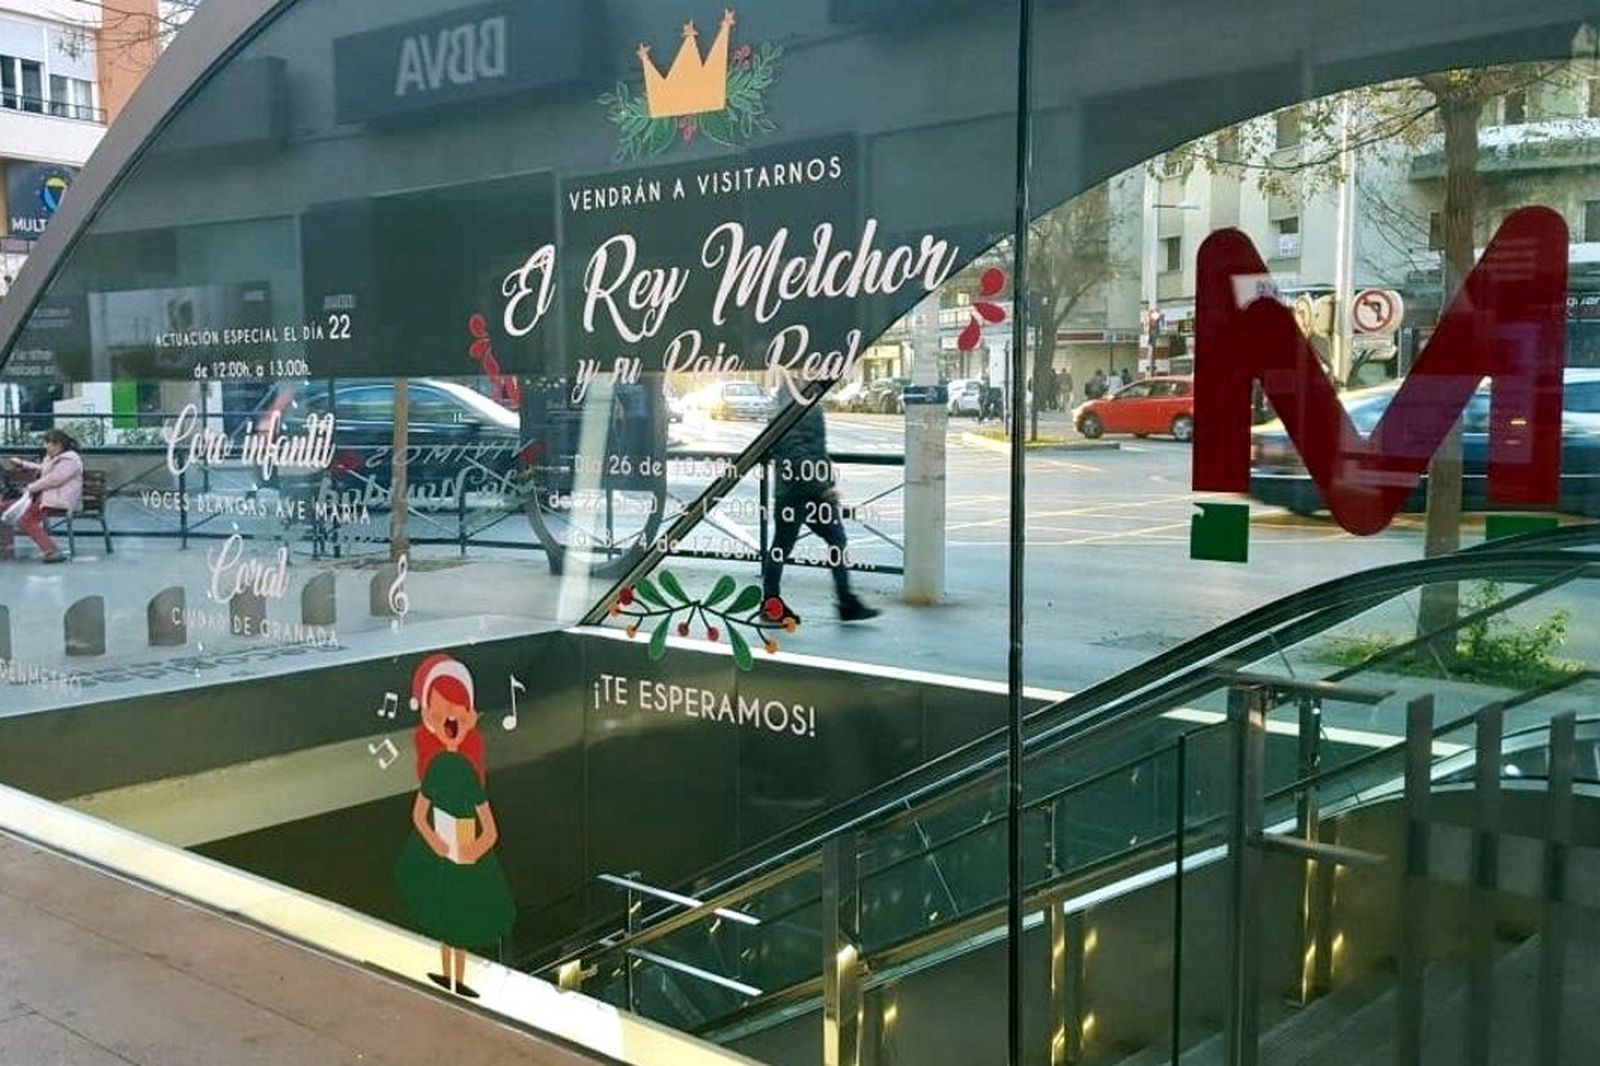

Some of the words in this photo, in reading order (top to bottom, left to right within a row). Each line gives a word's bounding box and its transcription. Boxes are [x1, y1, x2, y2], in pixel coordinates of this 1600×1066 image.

[569, 178, 661, 213] VENDRÁN
[673, 179, 686, 198] A
[697, 155, 842, 195] VISITARNOS
[502, 244, 556, 336] El
[584, 234, 689, 343] Rey
[701, 219, 958, 326] Melchor
[223, 326, 279, 345] ESPECIAL
[284, 326, 298, 342] EL
[303, 320, 324, 340] DÍA
[328, 314, 351, 340] 22
[194, 361, 208, 378] de
[256, 366, 265, 378] a
[572, 357, 600, 404] y
[765, 325, 862, 405] Real
[164, 403, 234, 476] Coro
[241, 410, 336, 481] infantil
[609, 454, 632, 475] 26
[640, 455, 663, 476] de
[140, 490, 189, 512] VOCES
[276, 499, 306, 520] AVE
[782, 506, 795, 522] a
[207, 534, 290, 604] Coral
[771, 547, 784, 563] a
[233, 616, 252, 635] DE
[259, 620, 340, 648] GRANADA
[594, 673, 628, 712] ¡TE
[640, 680, 816, 738] ESPERAMOS!
